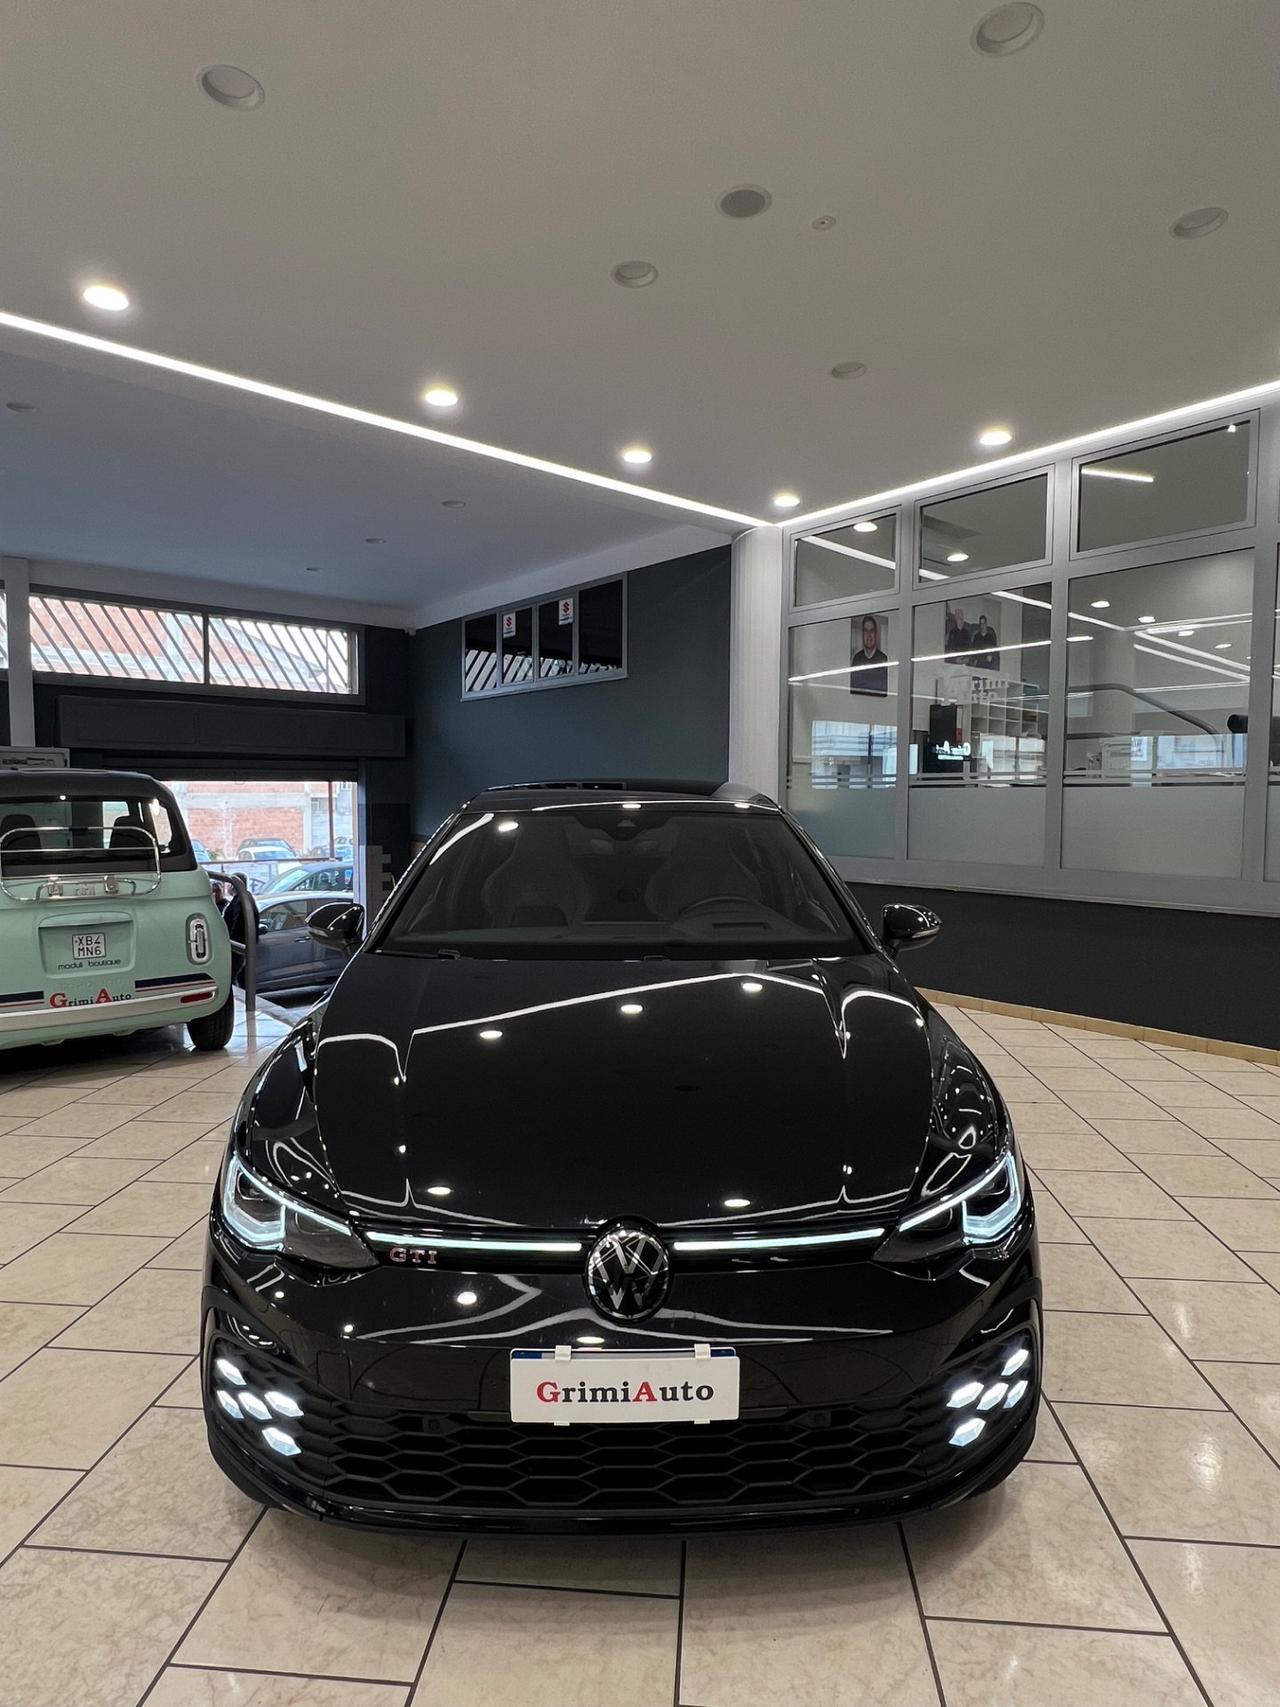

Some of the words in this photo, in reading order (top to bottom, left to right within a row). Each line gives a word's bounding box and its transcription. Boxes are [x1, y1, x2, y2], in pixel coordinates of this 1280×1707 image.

[77, 936, 101, 946] XB4
[77, 946, 102, 957] MN6
[49, 988, 132, 1008] GrimiAuto
[390, 1247, 438, 1264] GTI
[536, 1381, 714, 1403] GrimiAuto
